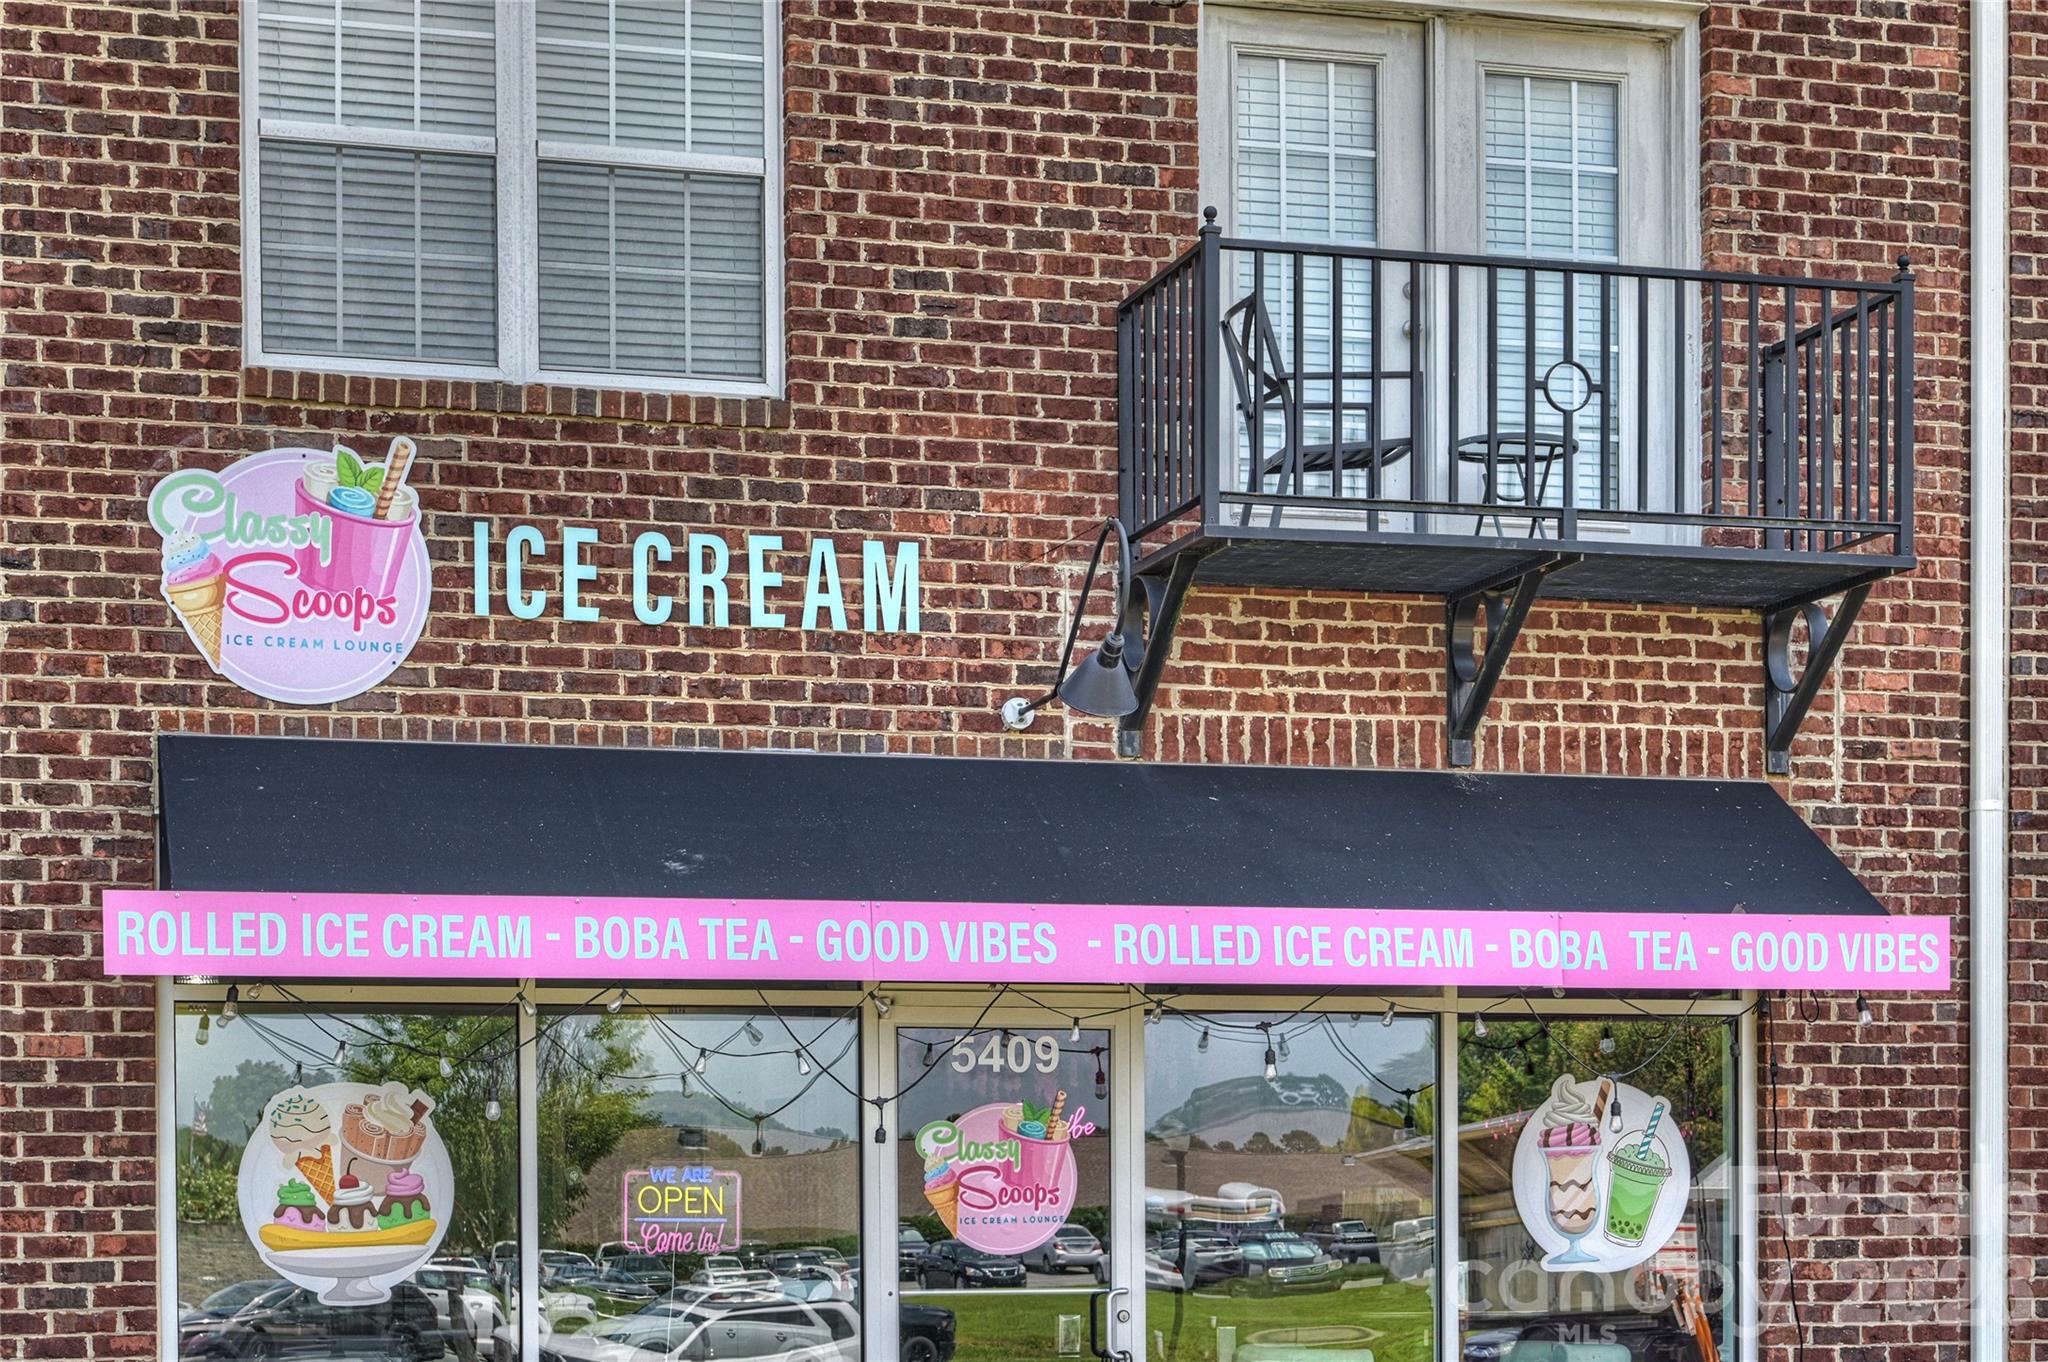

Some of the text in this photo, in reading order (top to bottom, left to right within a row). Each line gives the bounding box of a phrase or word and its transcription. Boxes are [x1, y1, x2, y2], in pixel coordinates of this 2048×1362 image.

[152, 473, 333, 563] Classy
[222, 551, 397, 632] Scoops
[472, 521, 922, 634] ICE CREAM
[226, 634, 404, 654] ICE CREAM LOUNGE
[117, 911, 287, 956] ROLLED
[302, 913, 369, 957] ICE
[382, 914, 532, 958] CREAM
[575, 916, 689, 960] BOBA
[699, 918, 778, 960] TEA
[816, 919, 930, 962] GOOD
[940, 922, 1058, 964] VIBES
[1114, 924, 1261, 965] ROLLED
[1273, 926, 1332, 966] ICE
[1343, 927, 1474, 967] CREAM
[1509, 929, 1608, 970] BOBA
[1629, 931, 1698, 971] TEA
[1731, 931, 1829, 972] GOOD
[1838, 934, 1940, 973] VIBES
[951, 1034, 1061, 1073] 5409
[915, 1120, 1021, 1170] Classy
[648, 1166, 714, 1184] WE ARE
[957, 1165, 1060, 1211] Scoops
[637, 1185, 724, 1215] OPEN
[959, 1215, 1065, 1225] ICE CREAM LOUNGE
[640, 1221, 725, 1255] Come In!
